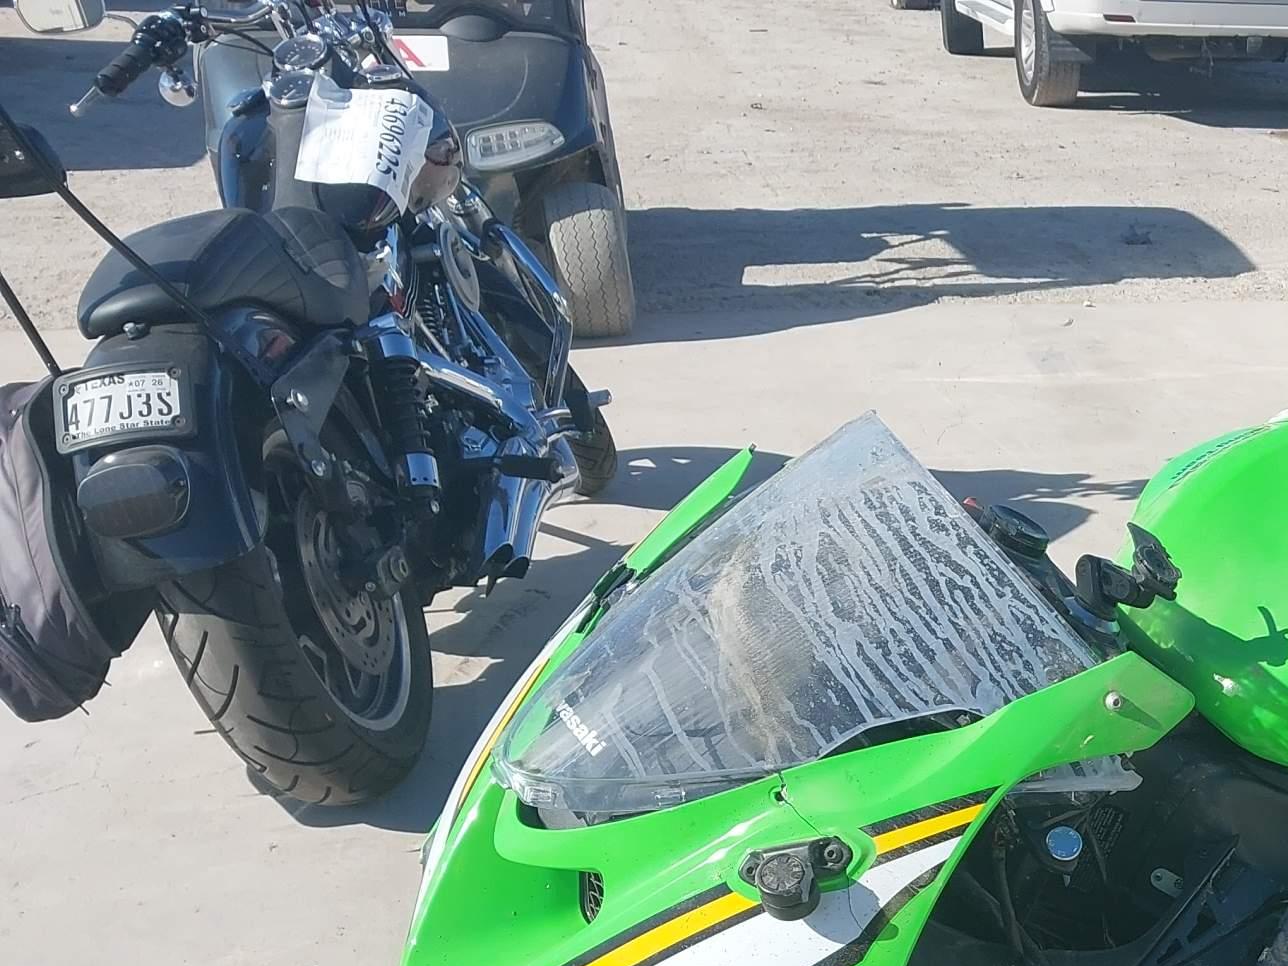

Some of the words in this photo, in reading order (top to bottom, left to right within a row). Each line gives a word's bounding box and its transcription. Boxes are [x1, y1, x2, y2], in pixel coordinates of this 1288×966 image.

[375, 97, 409, 182] 43696225
[84, 374, 126, 392] TEXAS
[134, 379, 146, 388] 07
[94, 425, 116, 435] Lone
[119, 420, 140, 429] Star
[143, 418, 172, 427] State
[556, 700, 607, 756] wasaki
